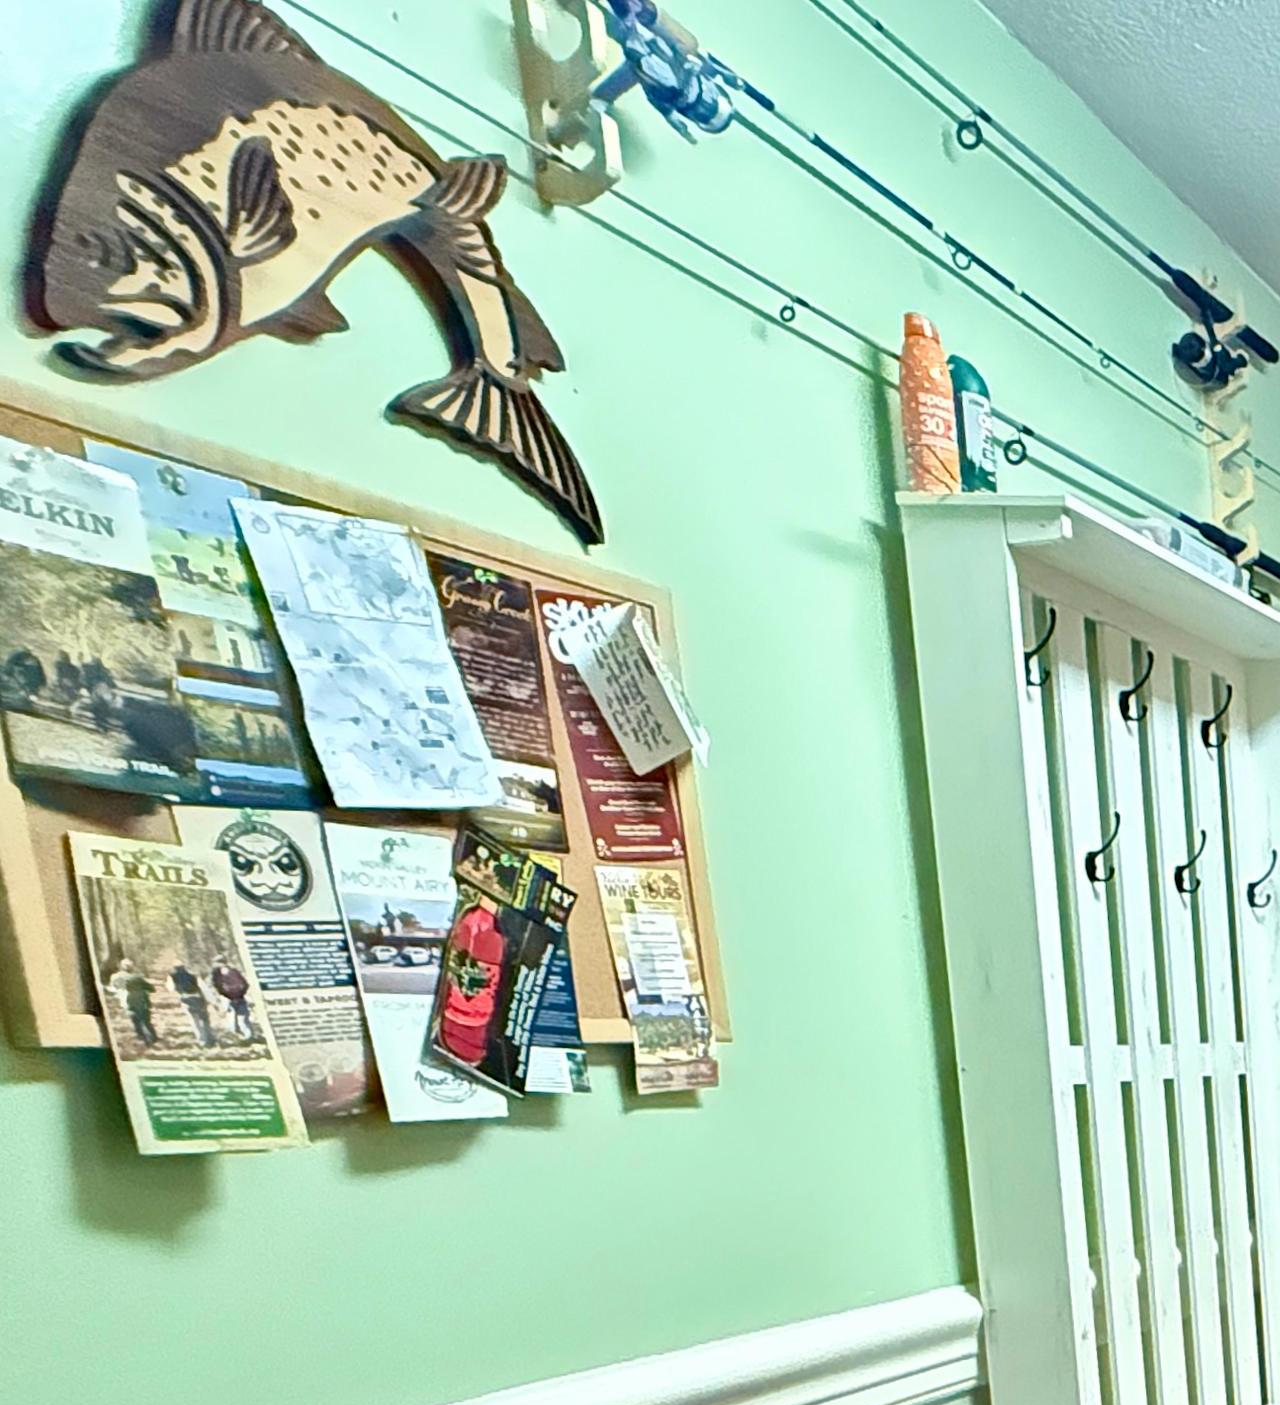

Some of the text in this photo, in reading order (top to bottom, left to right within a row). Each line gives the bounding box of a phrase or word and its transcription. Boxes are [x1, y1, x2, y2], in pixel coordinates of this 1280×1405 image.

[919, 414, 946, 436] 30
[0, 487, 116, 538] ELKIN
[90, 849, 209, 887] TRAILS
[414, 879, 449, 892] AIRY
[604, 884, 640, 899] WINE
